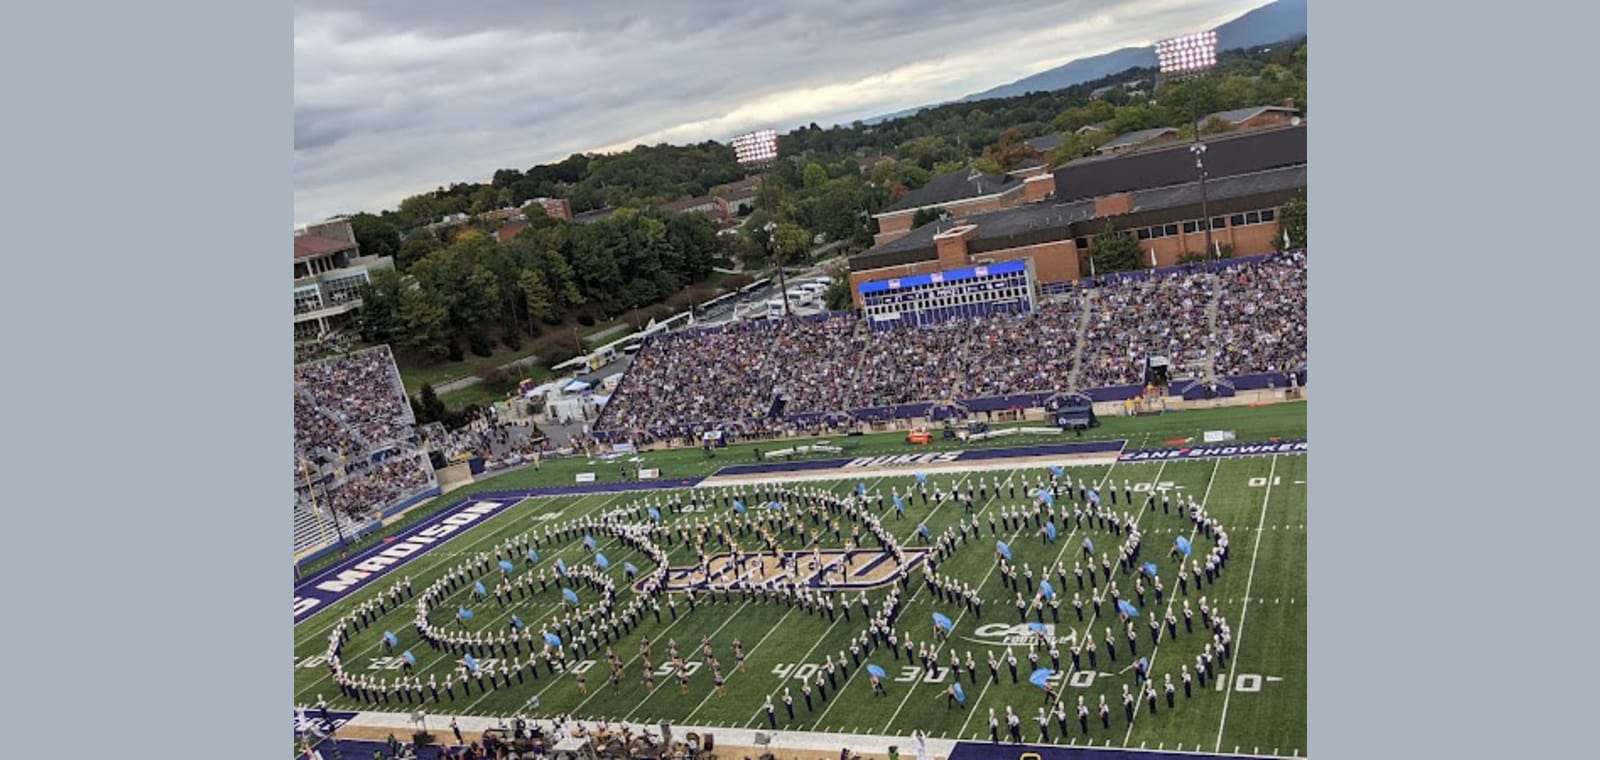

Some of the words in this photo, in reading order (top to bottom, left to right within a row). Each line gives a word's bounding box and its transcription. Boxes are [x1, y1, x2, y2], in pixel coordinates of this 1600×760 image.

[841, 451, 965, 468] DUKES
[1118, 450, 1185, 461] ZANE
[315, 500, 504, 592] MADISON
[654, 661, 703, 676] 50
[771, 663, 820, 678] 40
[894, 666, 950, 683] 30
[1215, 673, 1263, 692] 10
